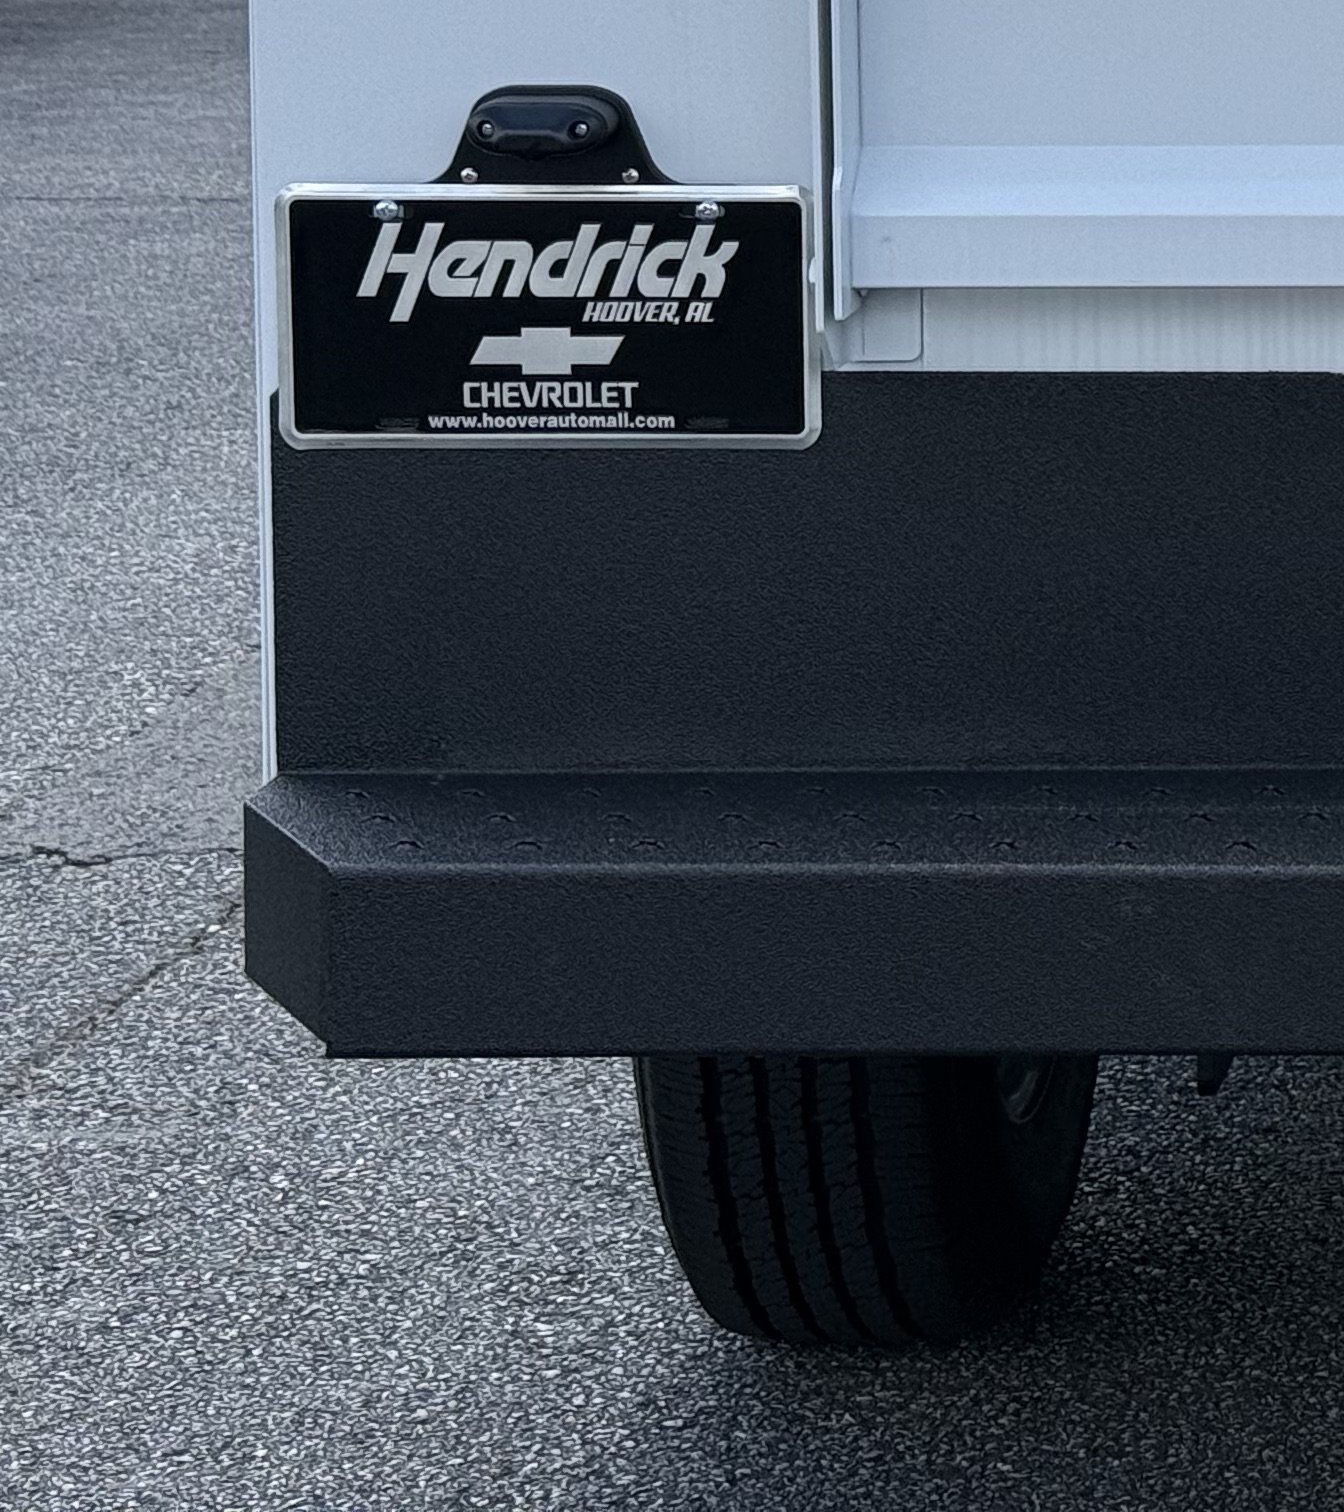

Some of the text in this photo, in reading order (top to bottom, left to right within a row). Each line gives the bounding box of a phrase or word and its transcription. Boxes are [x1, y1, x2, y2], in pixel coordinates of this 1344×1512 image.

[356, 222, 739, 322] Hendrick
[582, 301, 715, 325] HOOVER, AL
[462, 381, 639, 408] CHEVROLET
[428, 413, 676, 429] www.hooverautomall.com
